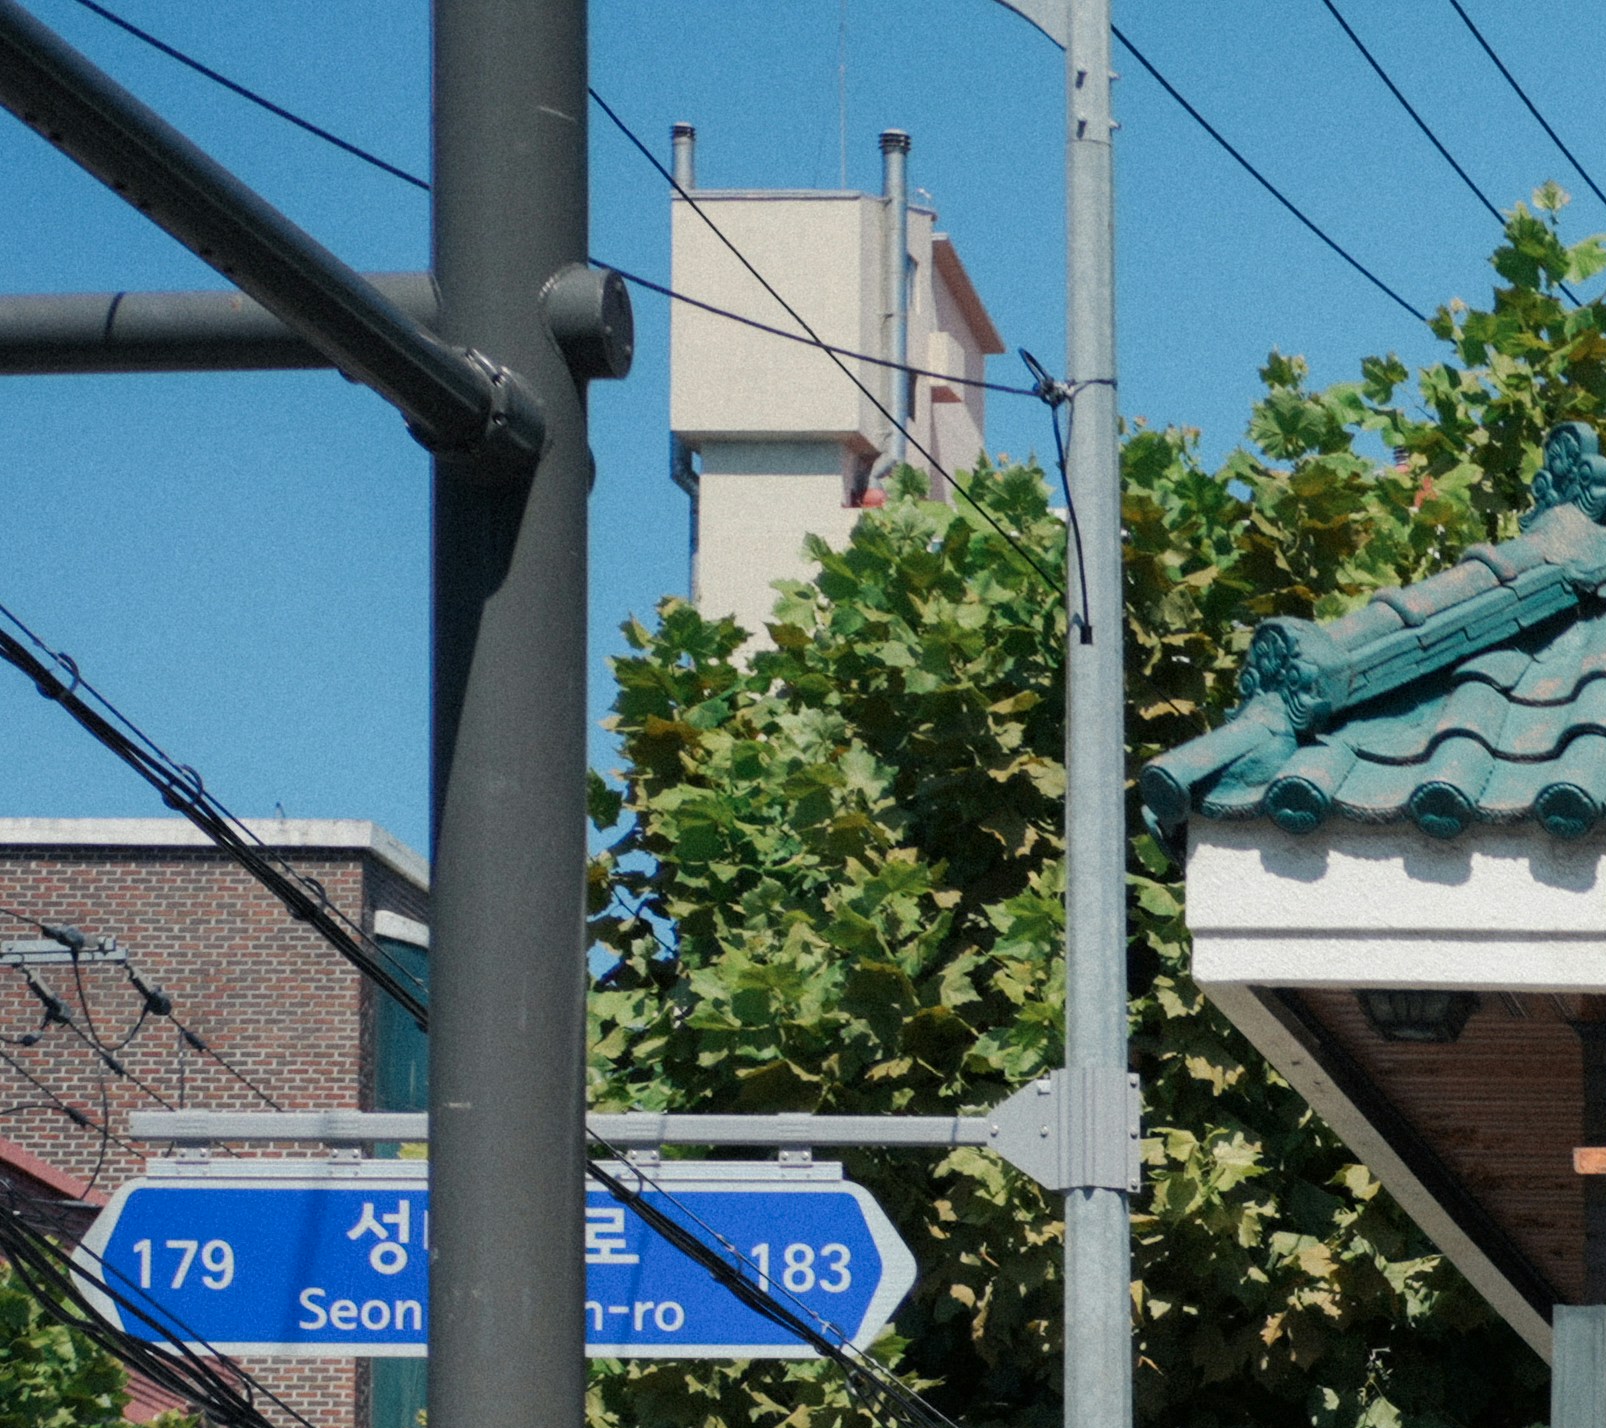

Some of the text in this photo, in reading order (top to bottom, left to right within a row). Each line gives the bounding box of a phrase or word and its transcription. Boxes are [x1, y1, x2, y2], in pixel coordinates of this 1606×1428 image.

[131, 1238, 235, 1291] 179
[347, 1201, 641, 1274] 성로
[751, 1241, 853, 1295] 183
